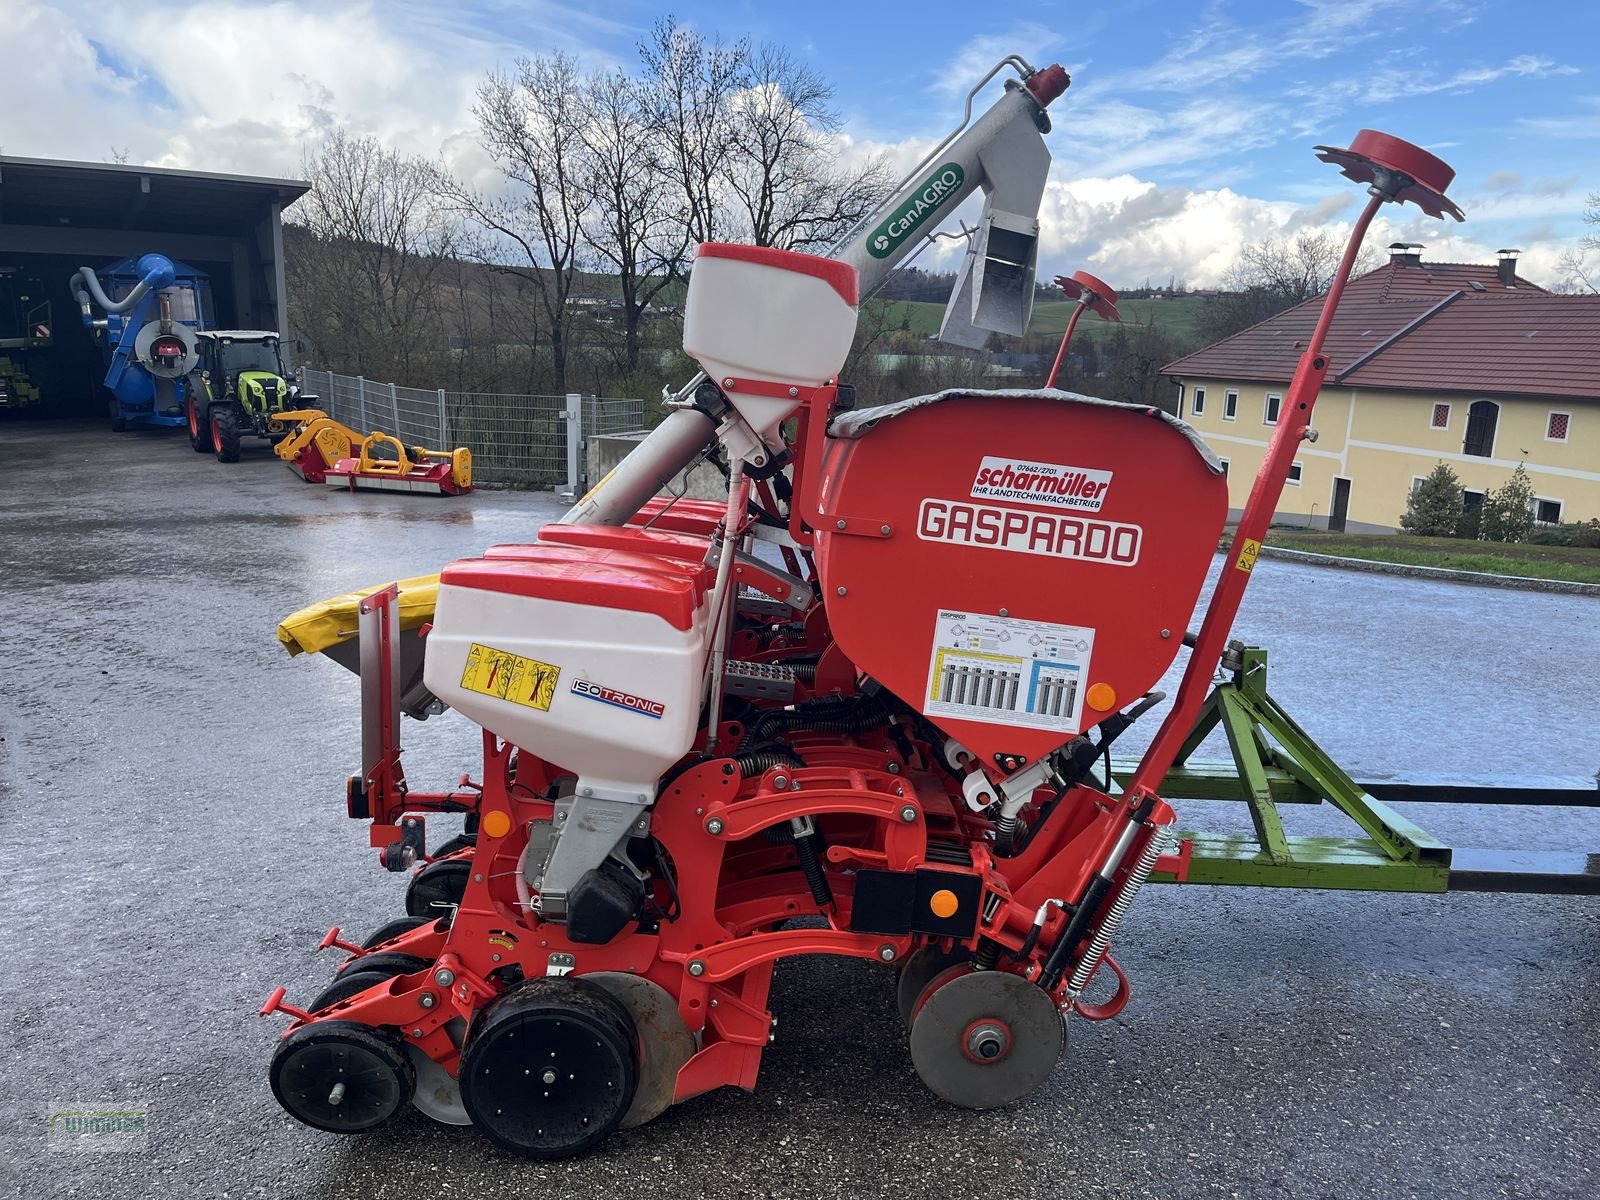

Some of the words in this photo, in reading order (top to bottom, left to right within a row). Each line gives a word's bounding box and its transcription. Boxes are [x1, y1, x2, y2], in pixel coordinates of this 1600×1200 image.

[888, 171, 956, 237] CanAGRO
[977, 464, 1107, 499] scharmüller
[1017, 464, 1057, 475] 07662/2701
[972, 486, 988, 495] IHR
[989, 487, 1101, 509] LANDTECHNIKFACHBETRIEB
[920, 501, 1139, 563] GASPARDO
[573, 680, 665, 714] ISOTRONIC
